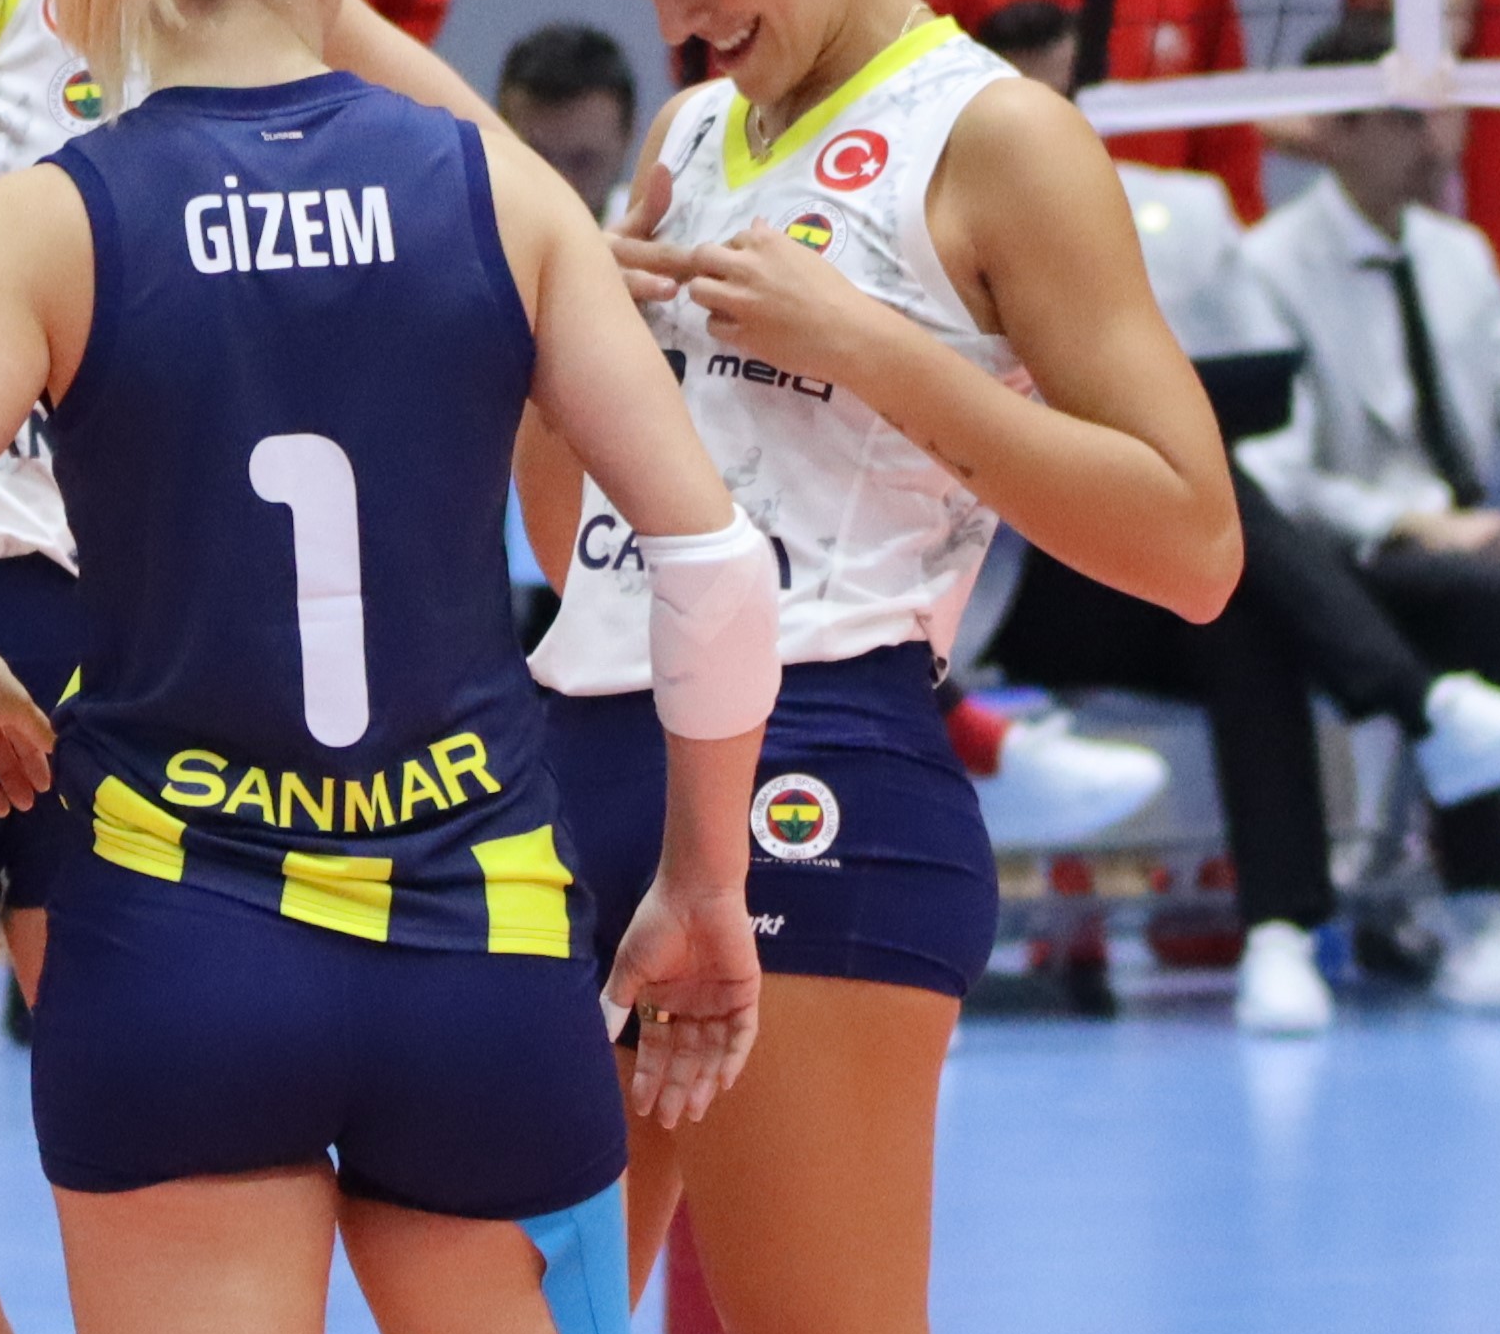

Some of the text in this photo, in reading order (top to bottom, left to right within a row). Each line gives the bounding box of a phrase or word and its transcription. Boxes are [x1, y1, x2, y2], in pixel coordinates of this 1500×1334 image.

[184, 176, 396, 273] GİZEM
[249, 433, 370, 748] 1
[161, 731, 501, 834] SANMAR
